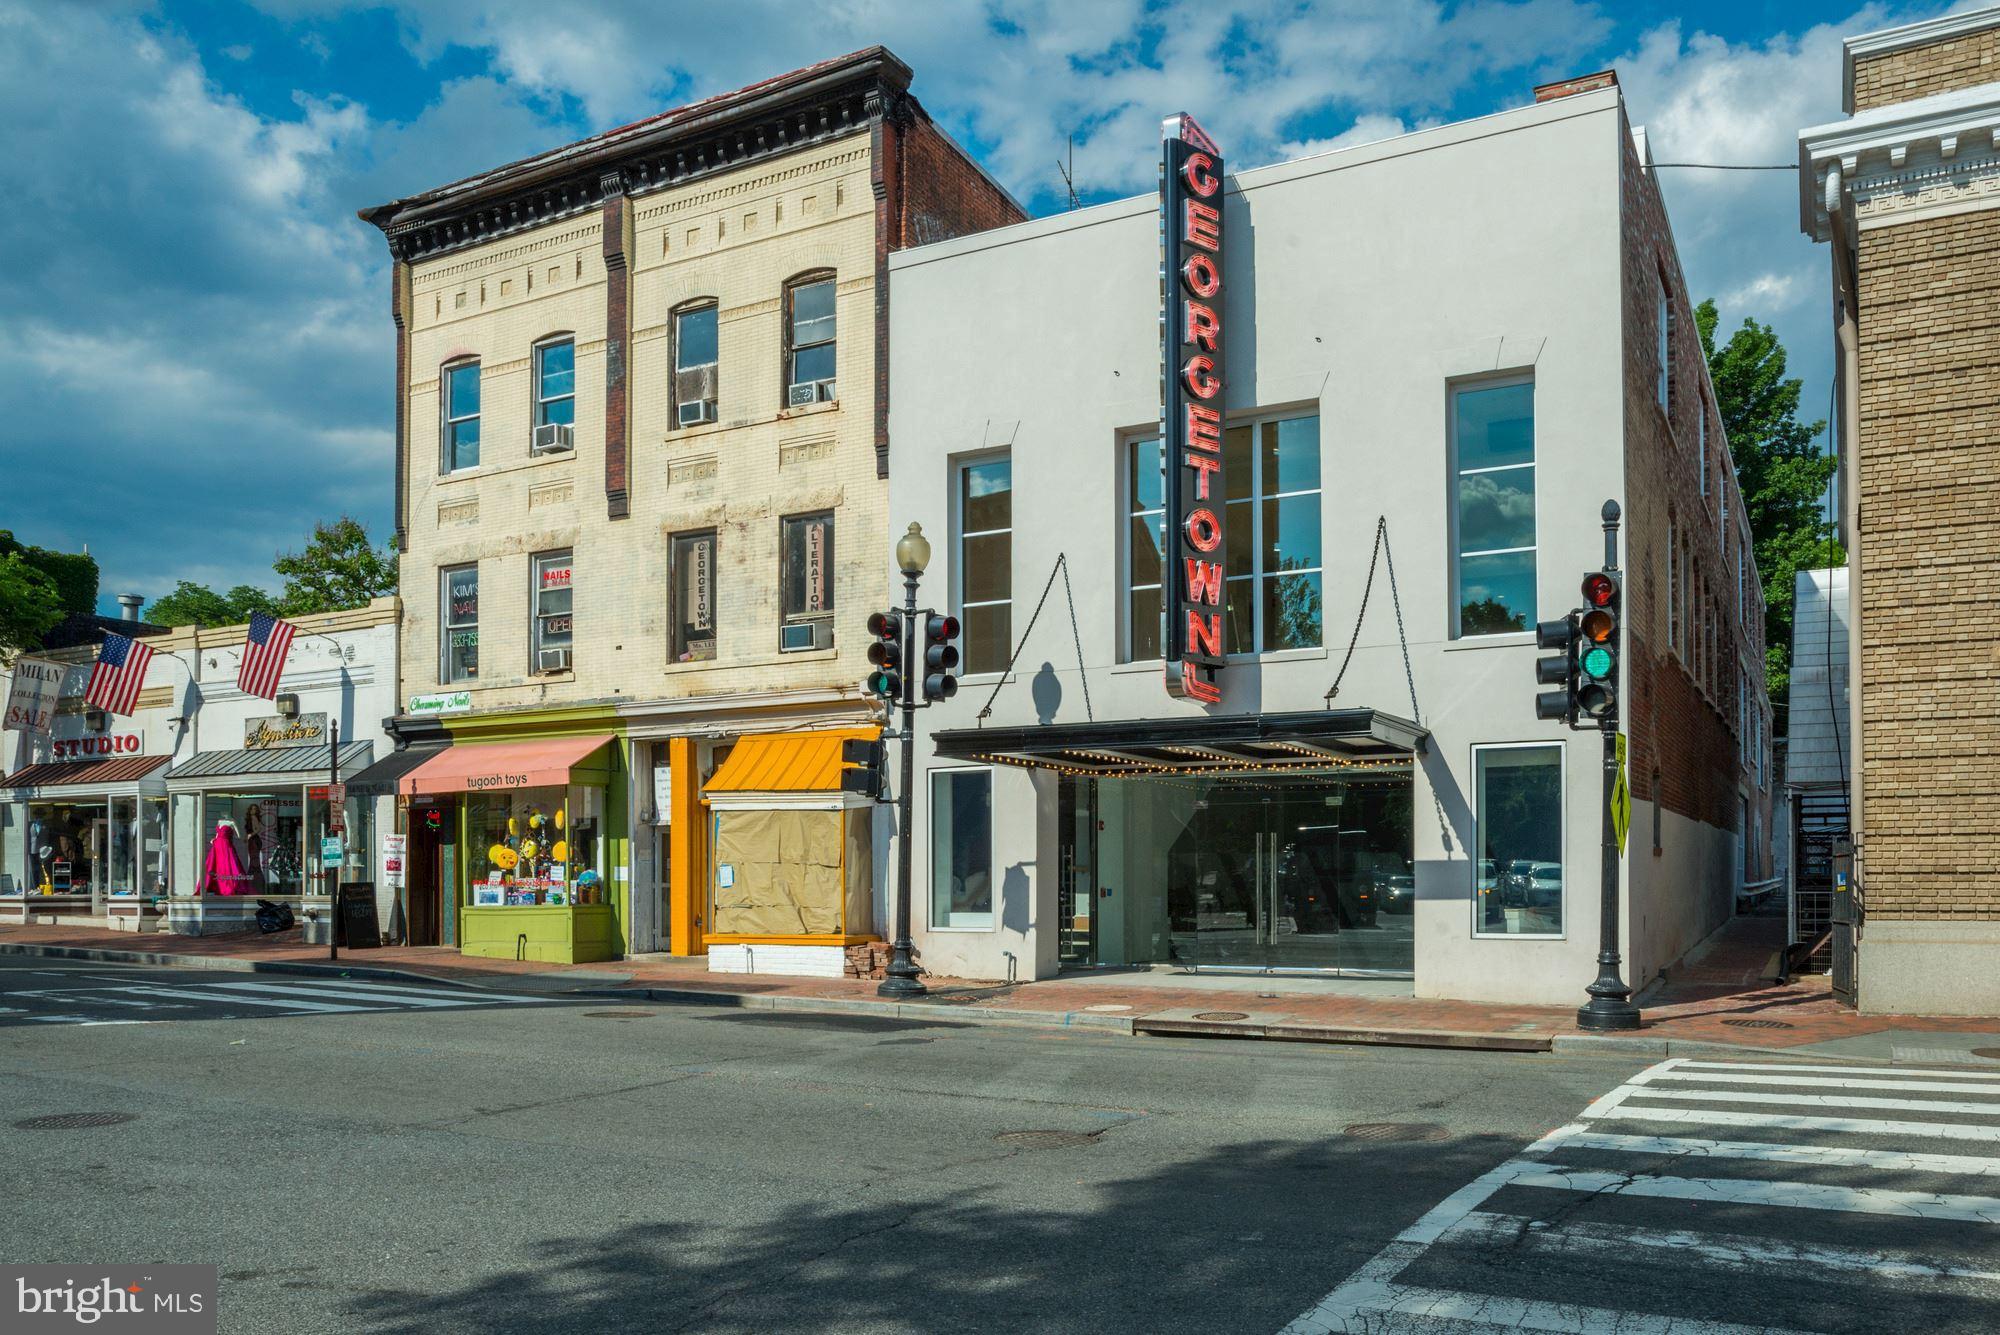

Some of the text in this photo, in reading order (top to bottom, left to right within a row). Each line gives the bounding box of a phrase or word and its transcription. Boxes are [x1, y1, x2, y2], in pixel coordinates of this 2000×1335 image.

[1181, 152, 1221, 658] GEORGETOWN
[543, 569, 571, 581] NAILS
[697, 542, 707, 628] GEORGETOWN
[18, 663, 61, 683] MILAN
[13, 688, 57, 703] COLLECTION
[410, 697, 445, 712] Charming
[10, 705, 48, 728] SALE
[54, 734, 140, 757] STUDIO
[467, 773, 527, 790] tugooh toys
